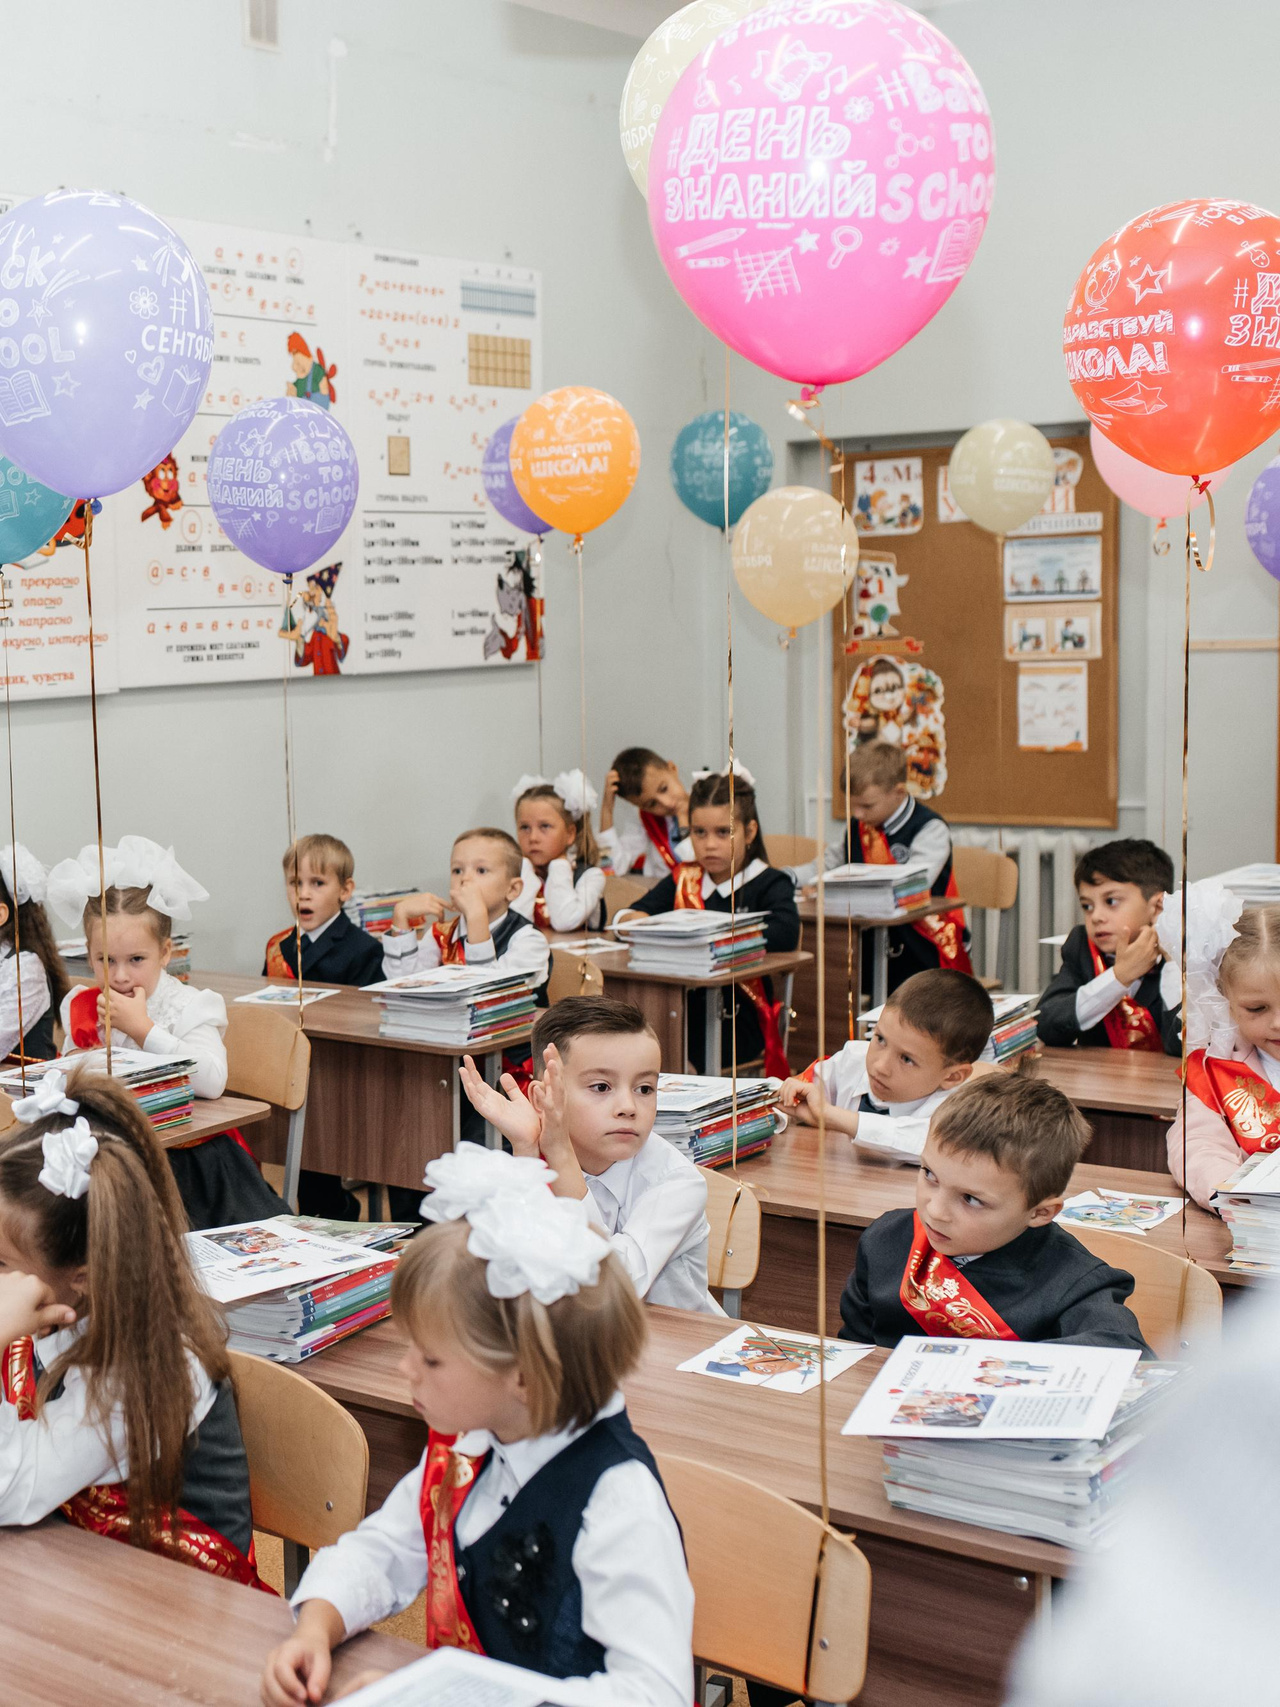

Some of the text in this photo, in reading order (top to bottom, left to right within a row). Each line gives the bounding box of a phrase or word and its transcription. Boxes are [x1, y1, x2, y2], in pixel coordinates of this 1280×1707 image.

[667, 105, 852, 178] #ДЕНЬ
[663, 159, 877, 224] ЗНАНИЙ
[1224, 313, 1280, 349] ЗН
[530, 456, 610, 479] ШКОЛА!
[862, 461, 877, 485] 4
[20, 576, 81, 591] прекрасно
[23, 596, 64, 609] опасно
[19, 614, 73, 629] напрасно
[2, 635, 46, 651] вкусно,
[32, 671, 76, 686] чувства
